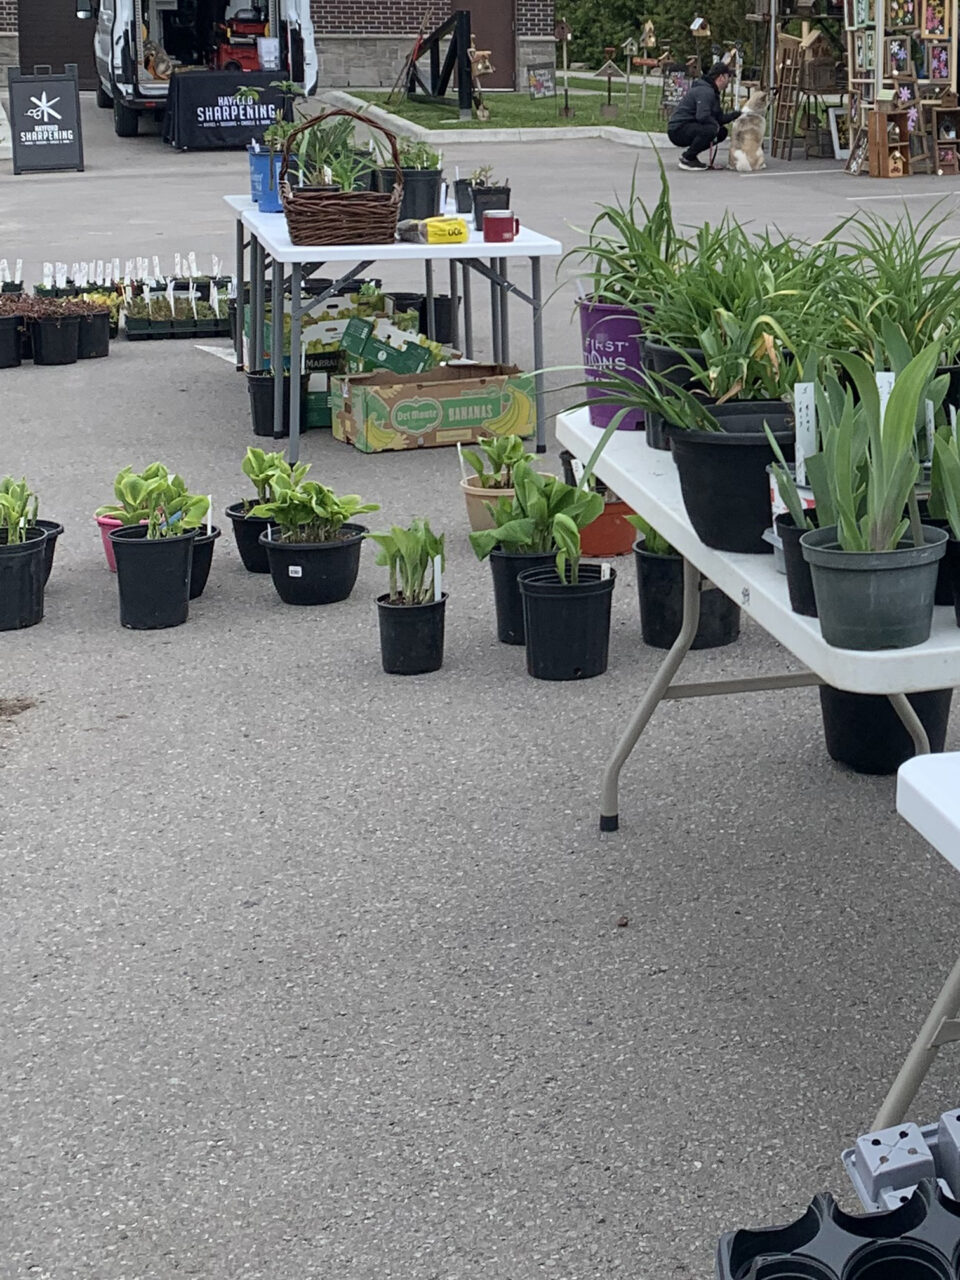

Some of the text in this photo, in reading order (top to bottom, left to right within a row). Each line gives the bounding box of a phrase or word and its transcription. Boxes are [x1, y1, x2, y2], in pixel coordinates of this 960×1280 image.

[197, 104, 276, 122] SHARPENING
[20, 130, 74, 142] SHARPENING
[448, 404, 493, 421] BANANAS
